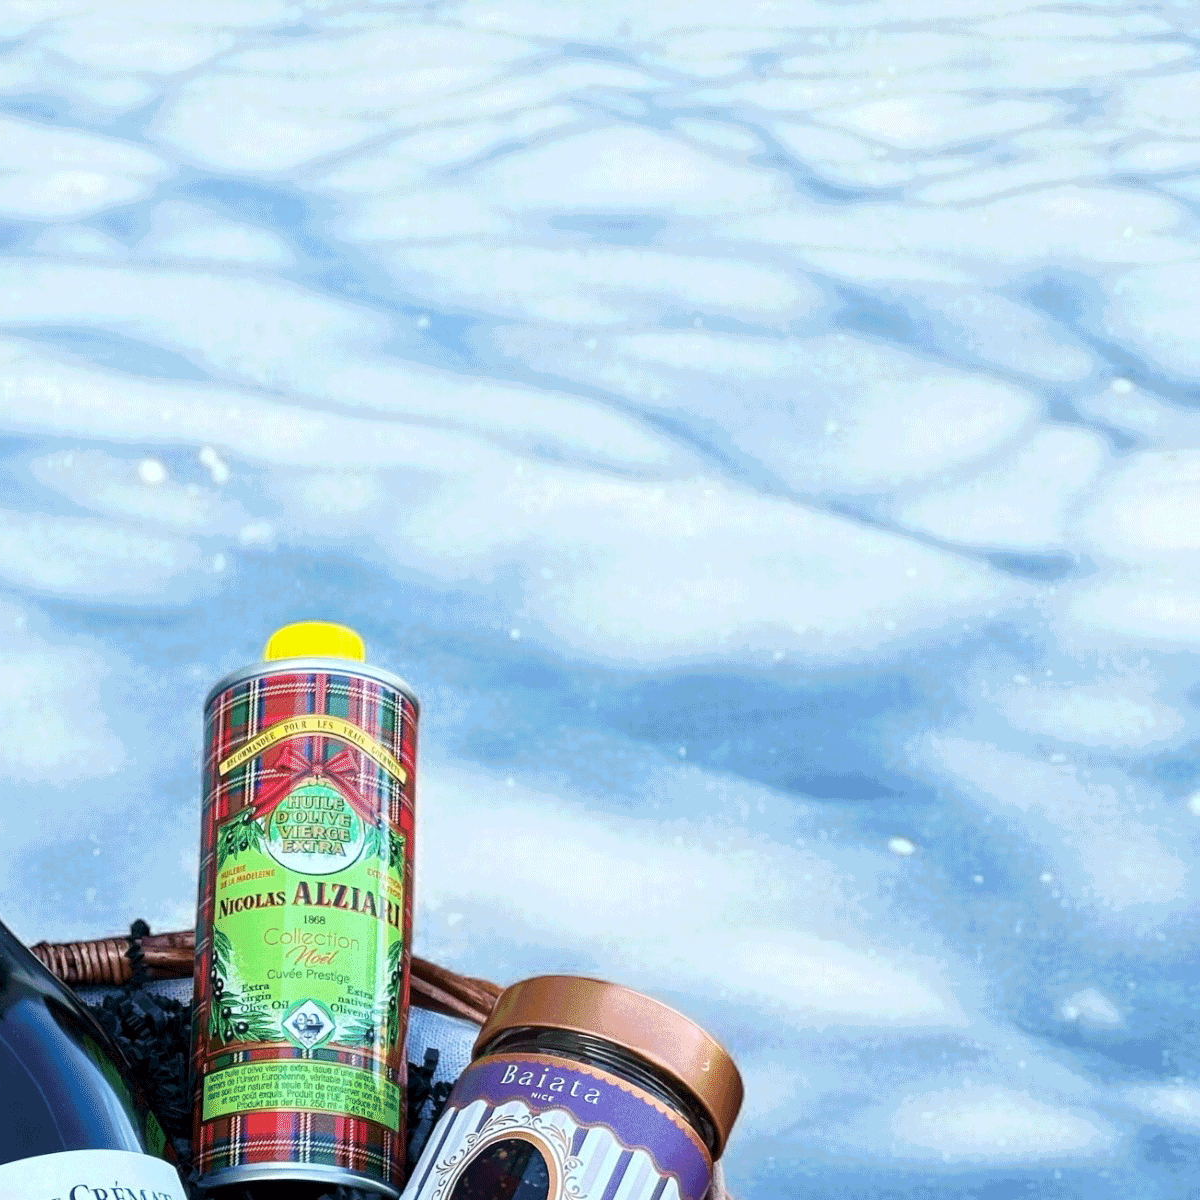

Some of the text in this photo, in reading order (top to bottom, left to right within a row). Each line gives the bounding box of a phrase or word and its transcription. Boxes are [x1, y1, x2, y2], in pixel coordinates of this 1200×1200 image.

[283, 720, 307, 733] POUR
[317, 719, 334, 730] LES
[287, 796, 345, 812] HUILE
[276, 825, 351, 843] VIERGE
[282, 840, 347, 857] EXTRA
[218, 891, 287, 920] NICOLAS
[303, 914, 326, 925] 1868
[263, 927, 360, 951] Collection
[285, 944, 340, 968] Noël
[267, 968, 351, 985] Cuvée Prestige
[241, 983, 270, 993] Extra
[347, 985, 373, 1000] Extra
[241, 993, 272, 1003] virgin
[271, 1001, 289, 1010] Oil
[338, 996, 374, 1010] natives
[530, 1091, 555, 1103] NICE
